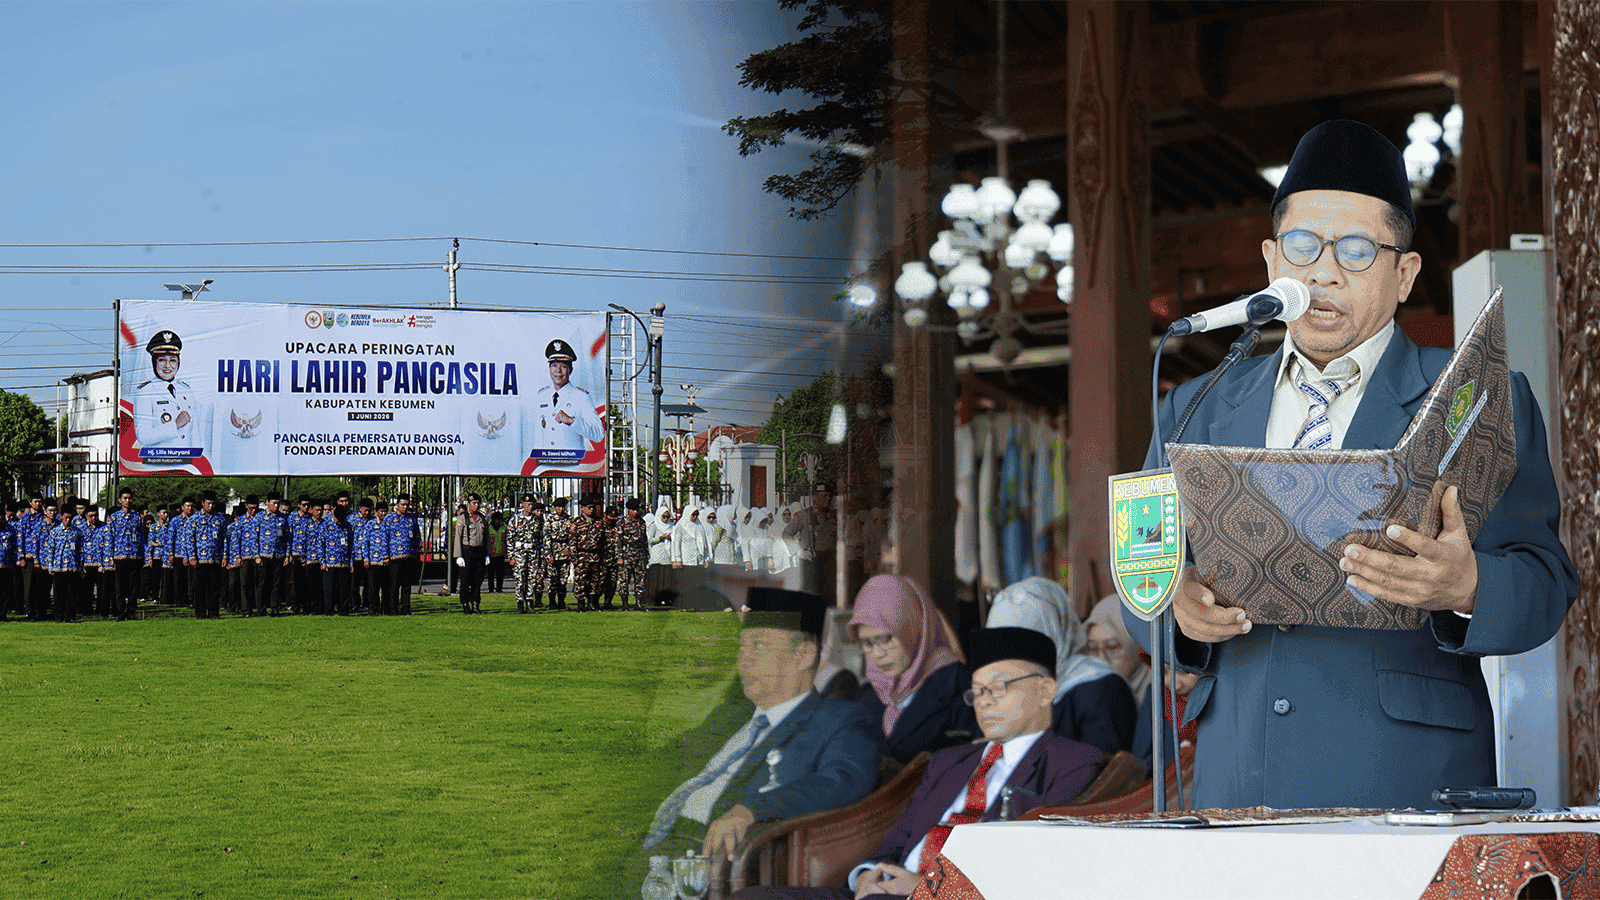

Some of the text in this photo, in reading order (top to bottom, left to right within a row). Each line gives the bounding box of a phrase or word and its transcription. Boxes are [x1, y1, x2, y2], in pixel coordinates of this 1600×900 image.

[285, 342, 455, 355] UPACARA PERINGATAN
[217, 359, 518, 395] HARI LAHIR PANCASILA
[305, 399, 435, 409] KABUPATEN KEBUMEN
[273, 433, 465, 445] PANCASILA PEMERSATU BANGSA,
[284, 445, 455, 456] FONDASI PERDAMAIAN DUNIA
[1115, 477, 1177, 499] KEBUMEN
